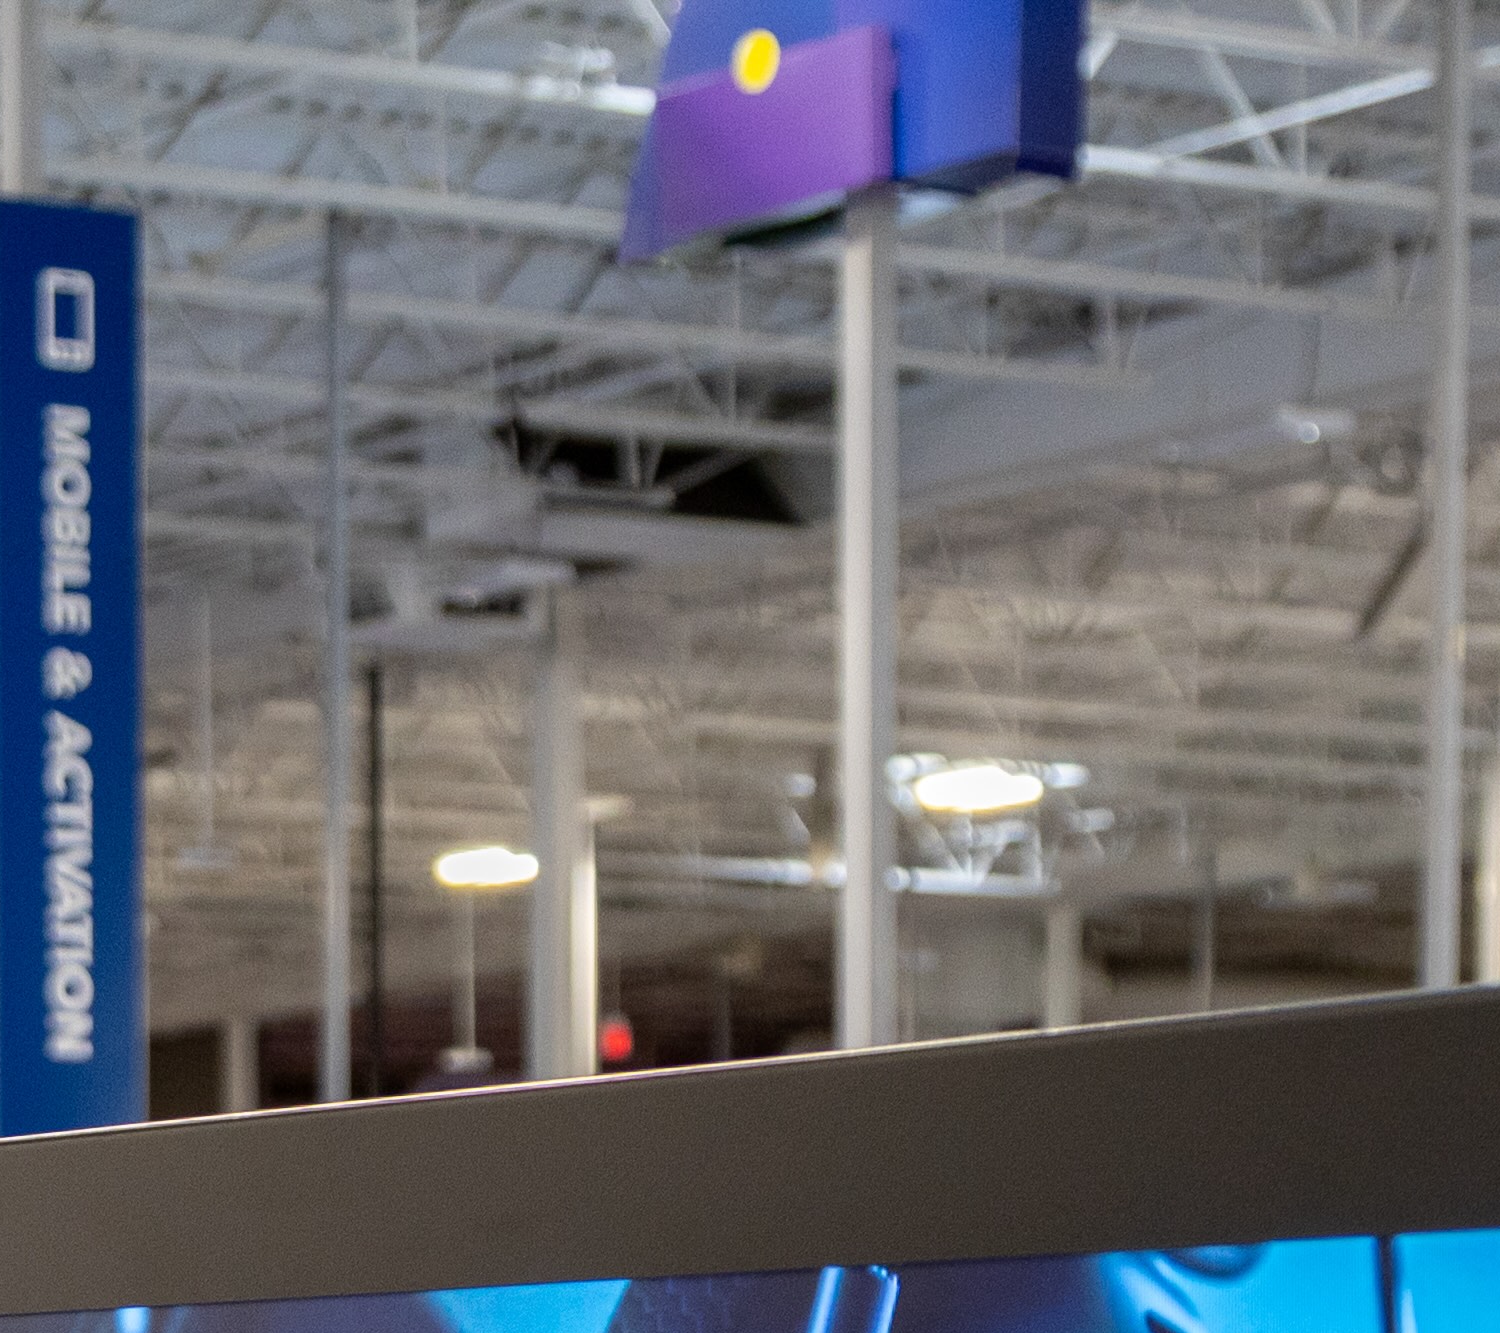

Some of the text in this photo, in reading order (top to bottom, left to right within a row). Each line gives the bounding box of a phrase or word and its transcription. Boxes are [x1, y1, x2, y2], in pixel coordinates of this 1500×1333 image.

[41, 403, 94, 1064] MOBILE & ACTIVATION
